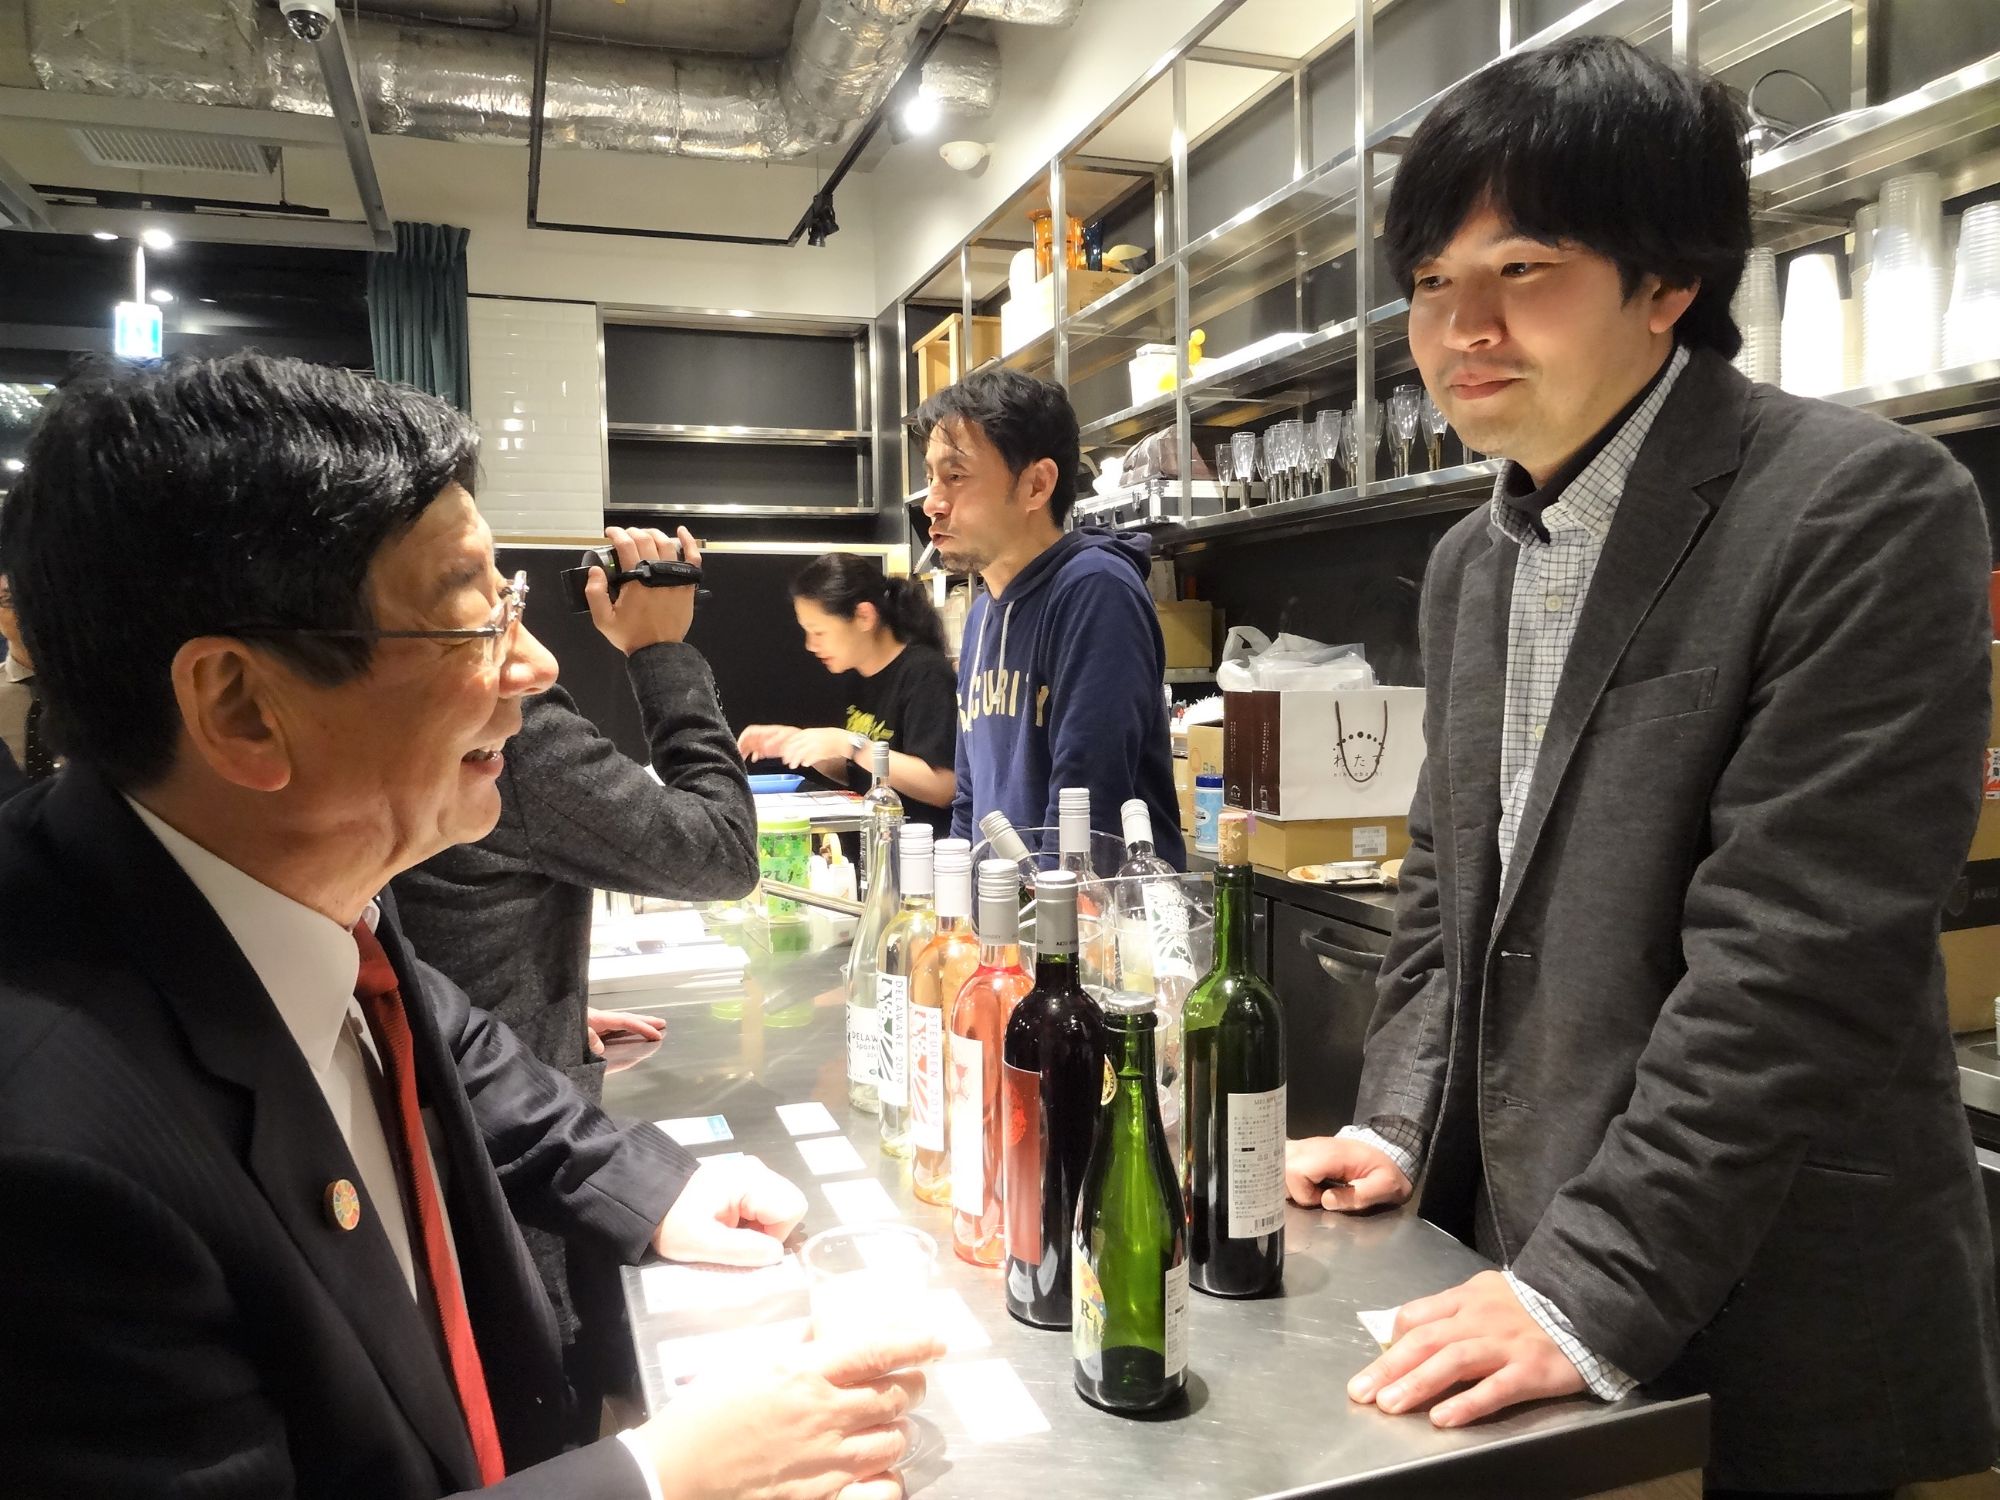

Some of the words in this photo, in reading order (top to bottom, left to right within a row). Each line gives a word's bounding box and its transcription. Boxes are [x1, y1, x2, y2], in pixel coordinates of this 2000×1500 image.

[671, 566, 691, 575] SONY
[956, 668, 1050, 733] CURIY
[896, 980, 904, 1047] DELAWARE
